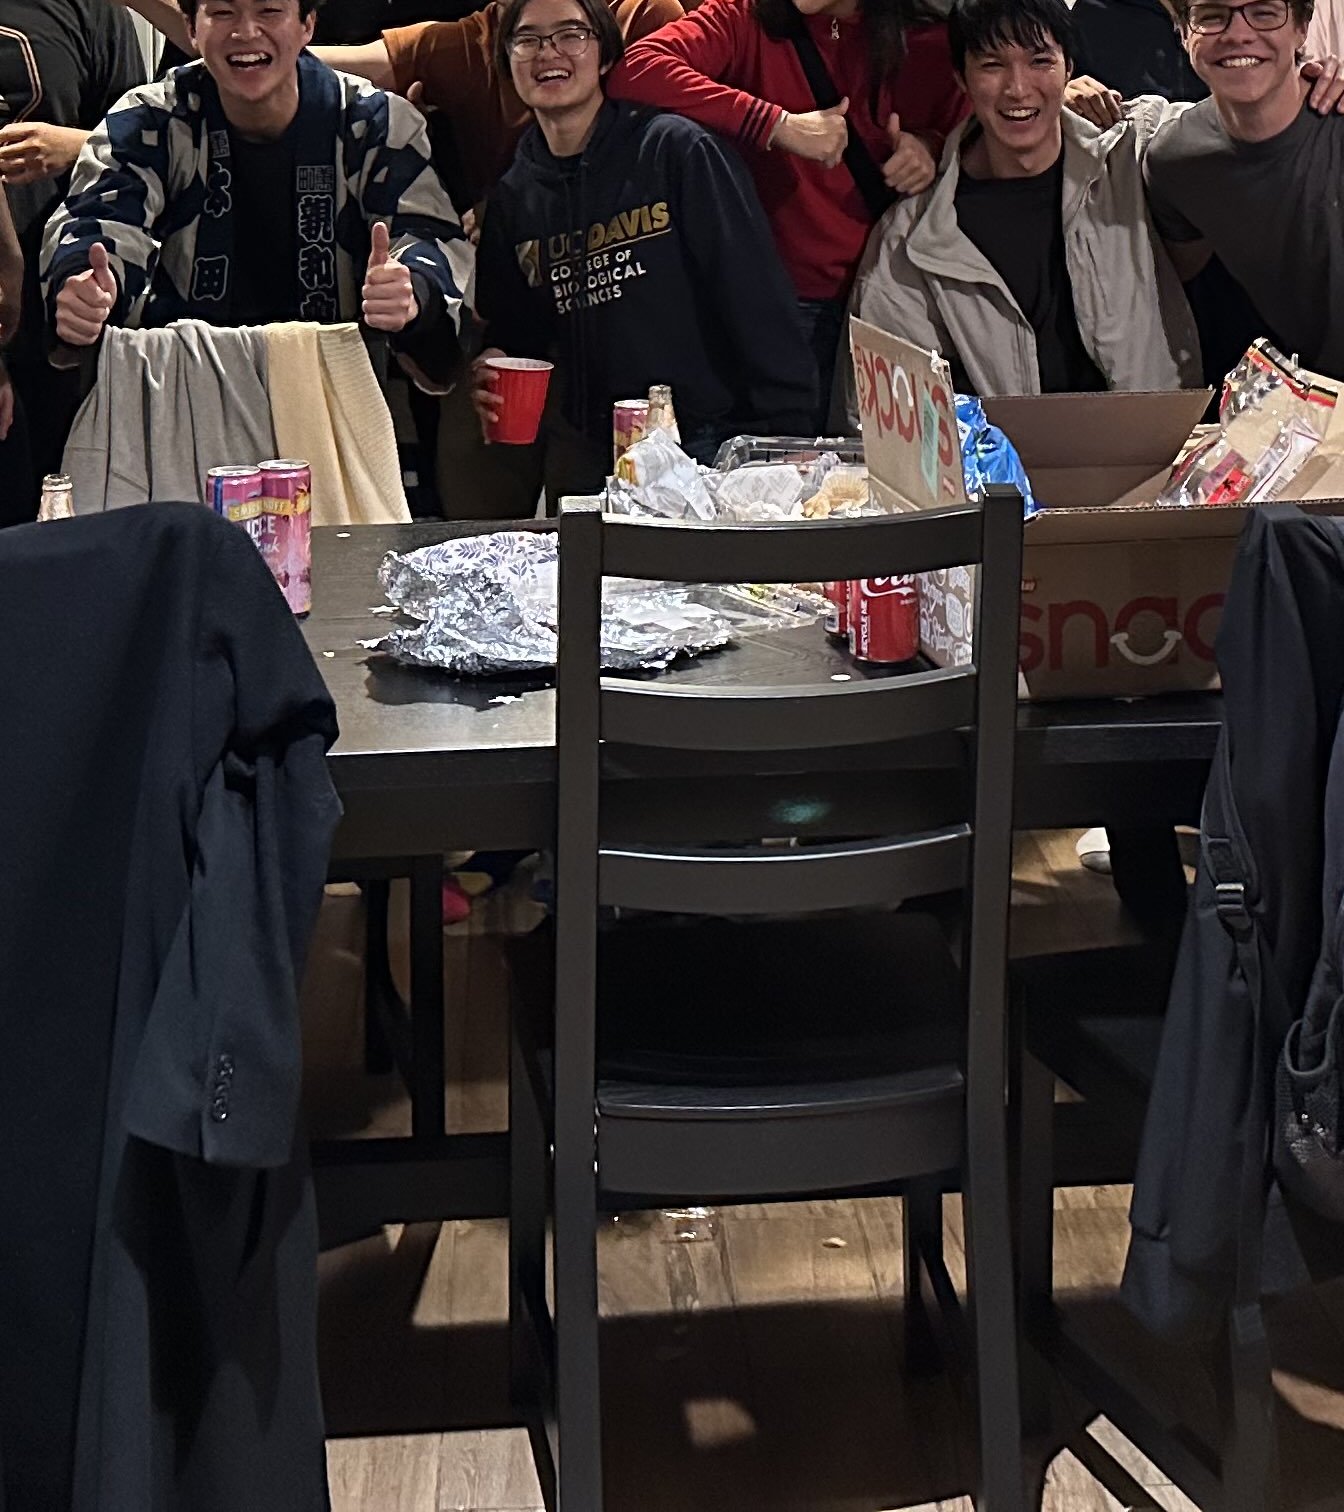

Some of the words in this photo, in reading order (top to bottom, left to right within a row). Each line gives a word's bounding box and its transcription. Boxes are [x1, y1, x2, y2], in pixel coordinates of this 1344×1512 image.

[587, 201, 670, 250] DAVIS
[550, 253, 610, 281] COEGE
[615, 249, 632, 263] OF
[552, 261, 647, 299] BIOOGICAL
[863, 351, 954, 468] sack
[1019, 592, 1226, 674] snac
